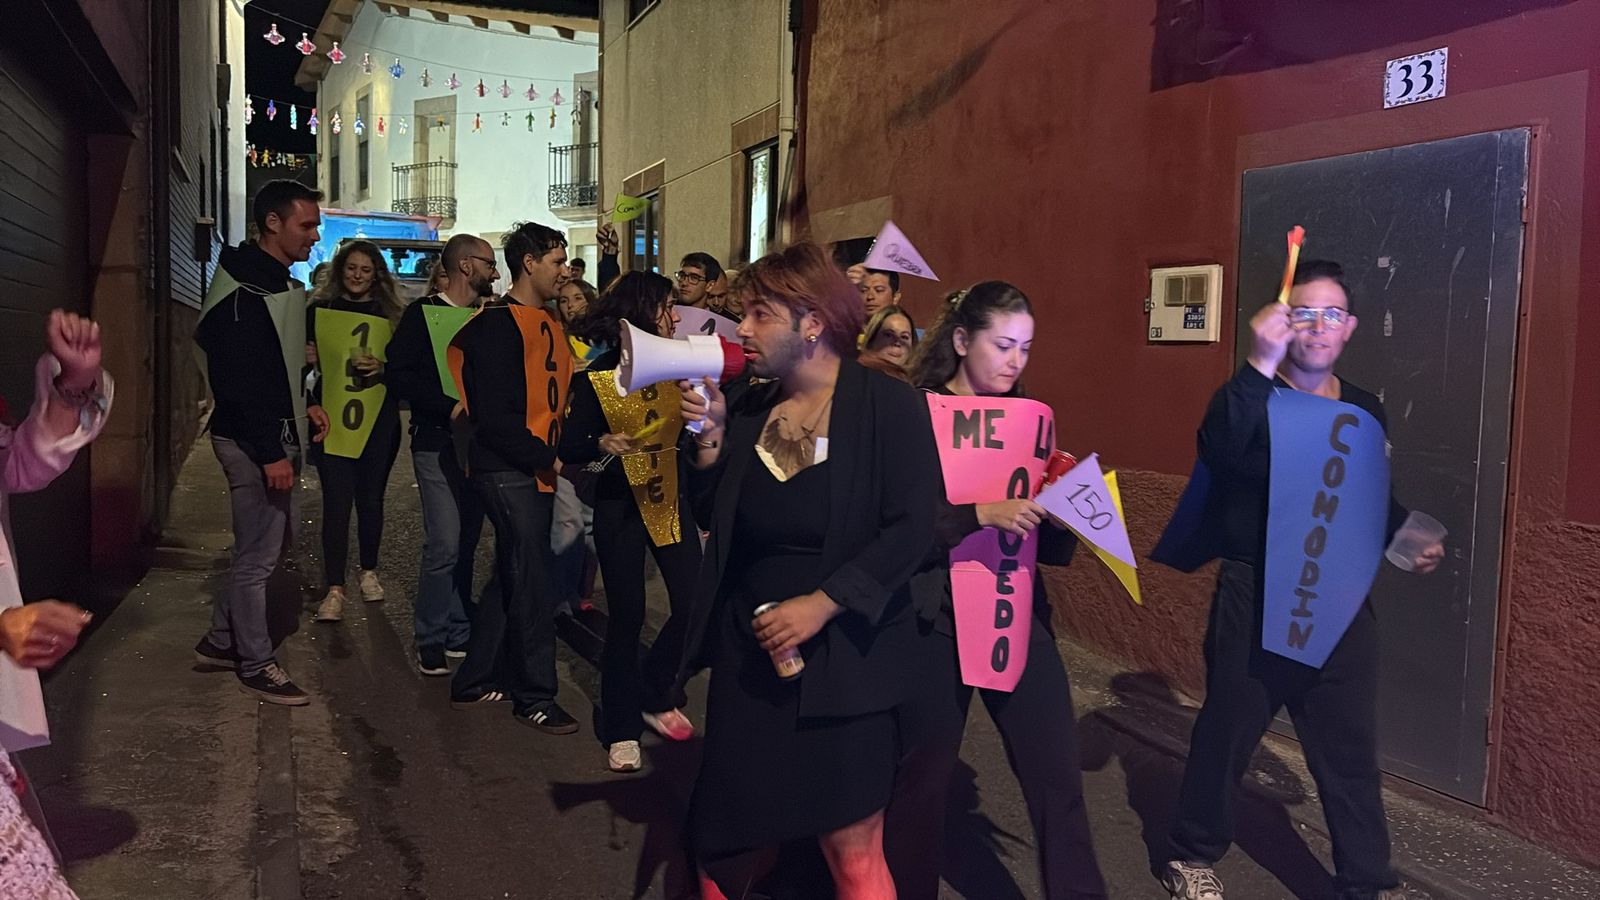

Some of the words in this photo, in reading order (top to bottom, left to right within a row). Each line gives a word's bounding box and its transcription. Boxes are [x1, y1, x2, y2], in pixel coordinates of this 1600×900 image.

[1397, 60, 1433, 98] 33
[541, 321, 559, 447] 200
[953, 409, 1006, 449] ME
[1066, 484, 1112, 530] 150
